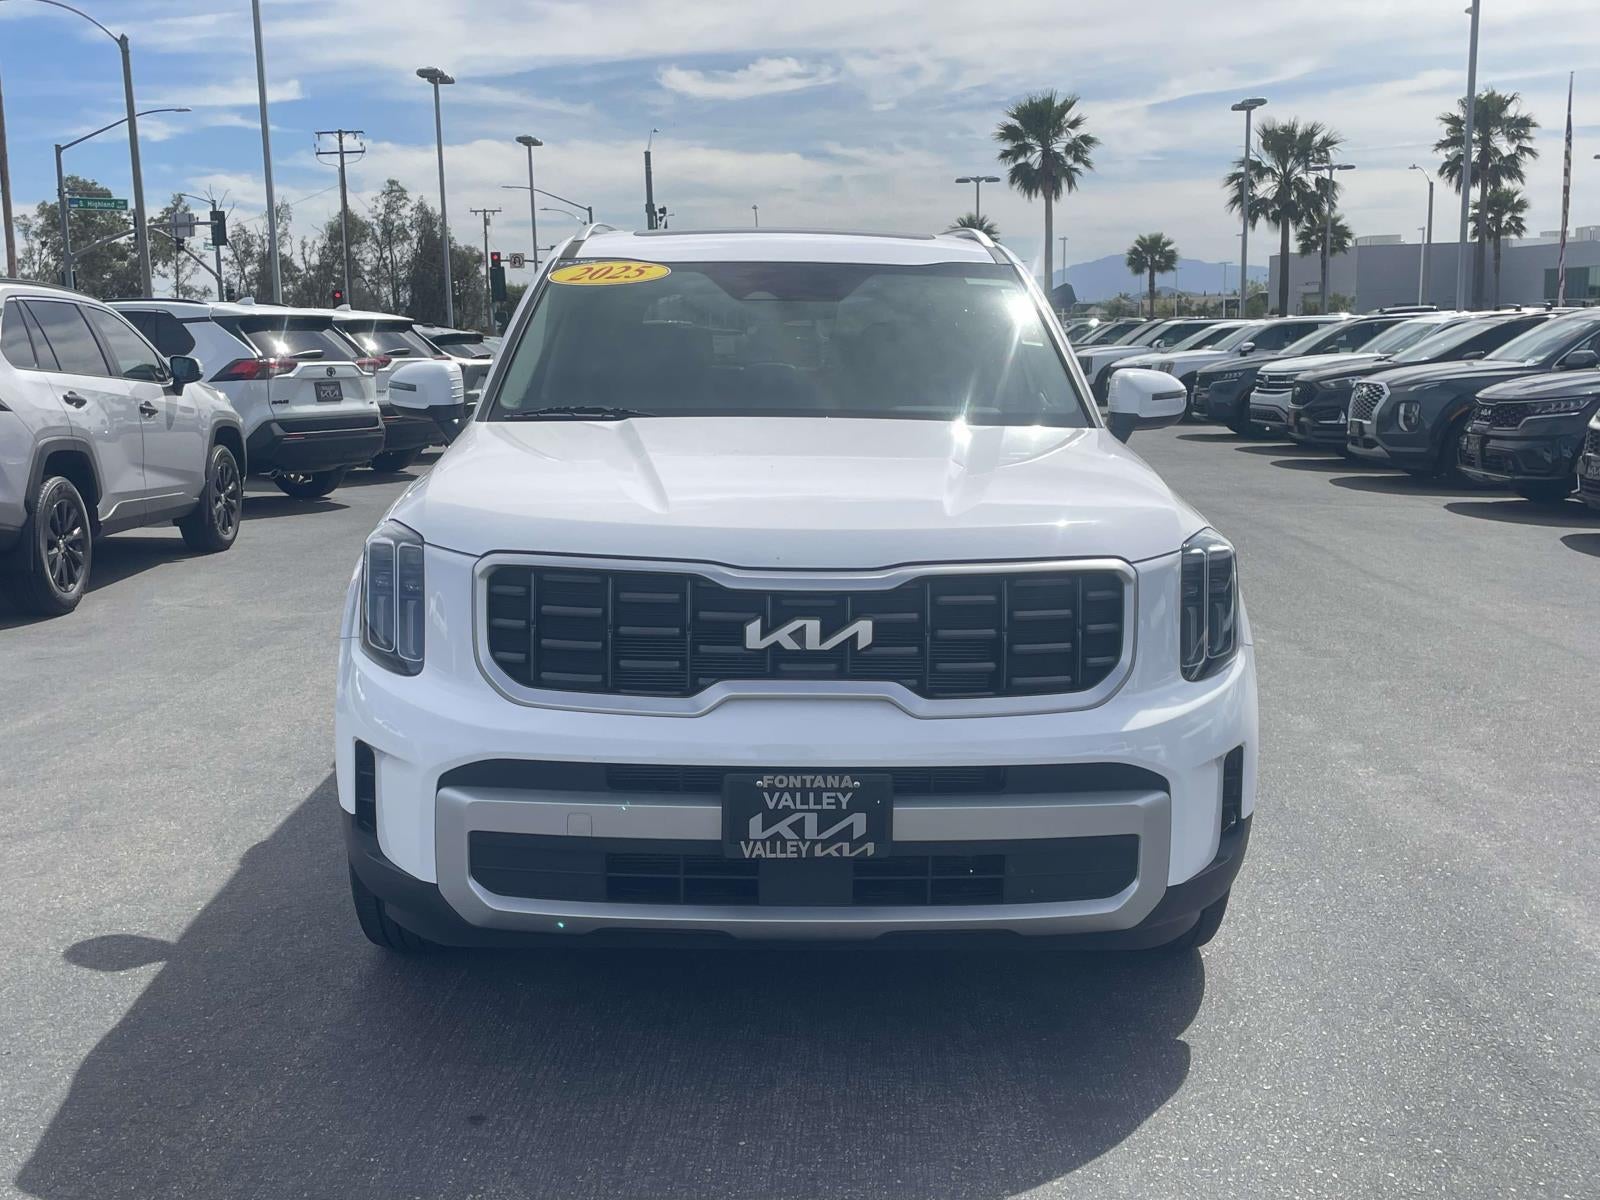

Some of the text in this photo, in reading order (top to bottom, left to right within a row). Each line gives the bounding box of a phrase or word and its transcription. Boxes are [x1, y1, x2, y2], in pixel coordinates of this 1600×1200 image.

[87, 200, 115, 209] Highland
[567, 266, 652, 281] 2025
[745, 617, 873, 651] KIA
[763, 775, 853, 788] FONTANA
[763, 792, 853, 810] VALLEY
[749, 812, 867, 841] KIA
[740, 841, 875, 858] VALLEY KIA
